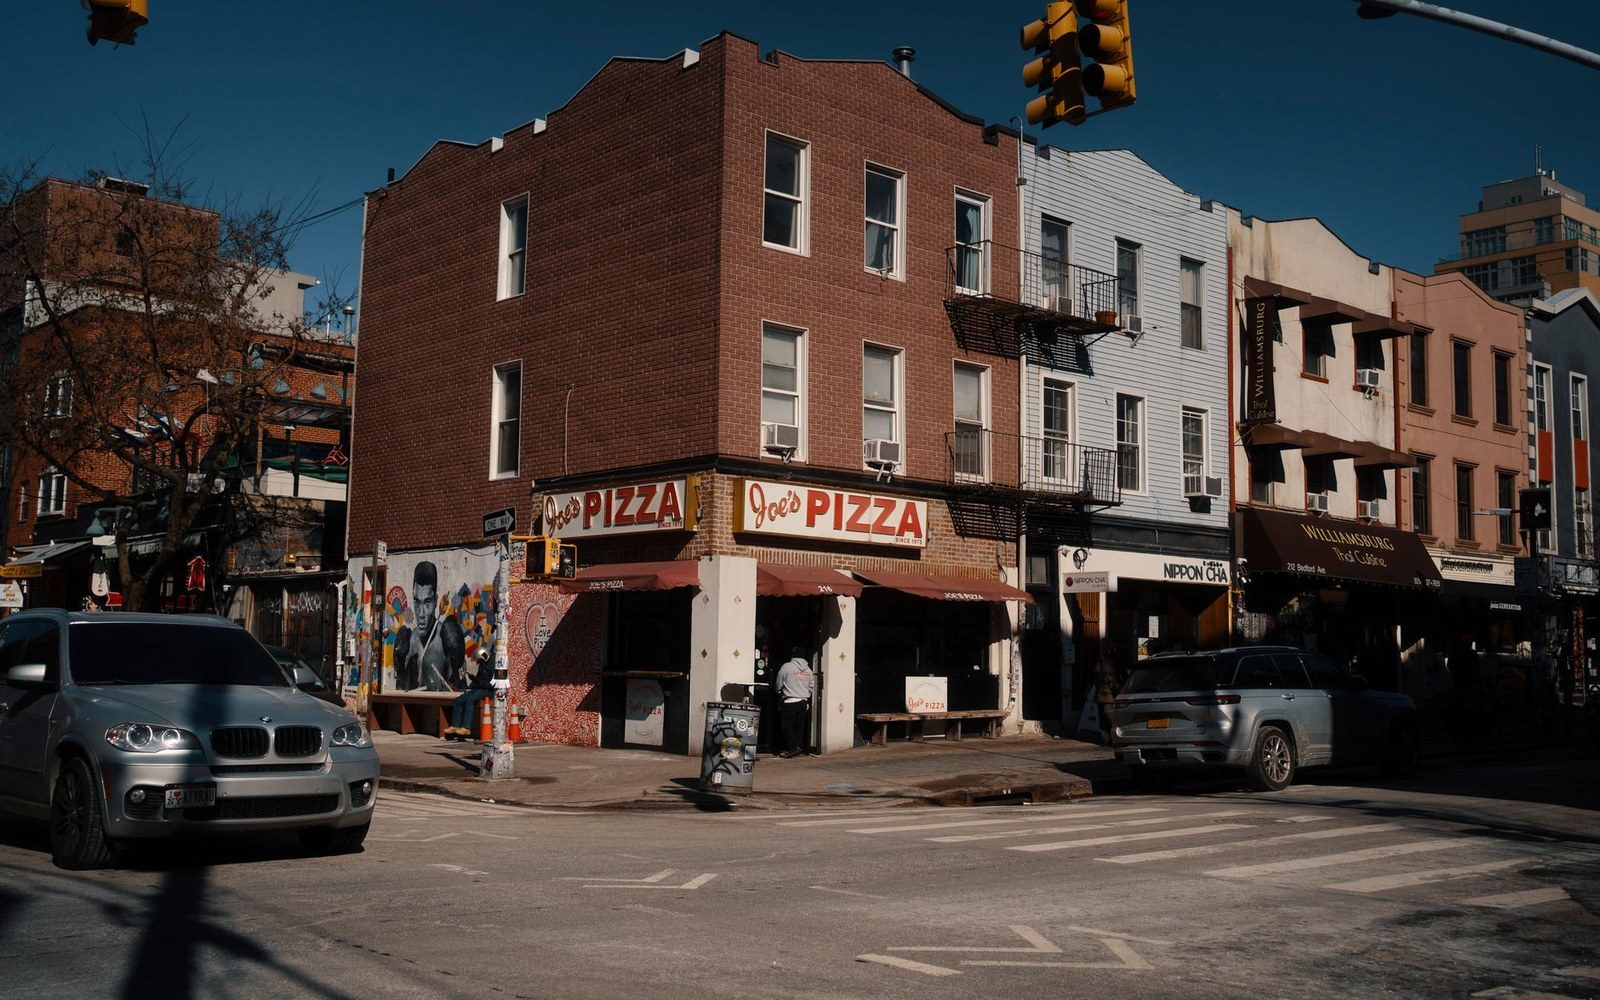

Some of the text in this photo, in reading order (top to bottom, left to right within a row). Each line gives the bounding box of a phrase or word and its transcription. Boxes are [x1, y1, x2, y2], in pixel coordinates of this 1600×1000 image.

[1255, 301, 1266, 397] WILLIAMSBURG
[545, 482, 682, 537] Joe's PIZZA
[749, 483, 923, 539] Joe's PIZZA
[1301, 524, 1395, 551] WILLIAMSBURG
[1287, 563, 1296, 571] 212
[1332, 547, 1388, 568] Thai Cuisine
[1164, 562, 1228, 583] NIPPON CHA
[589, 580, 624, 590] JOE'S PIZZA
[817, 585, 833, 593] 216
[540, 616, 546, 627] I
[925, 702, 946, 710] PIZZA
